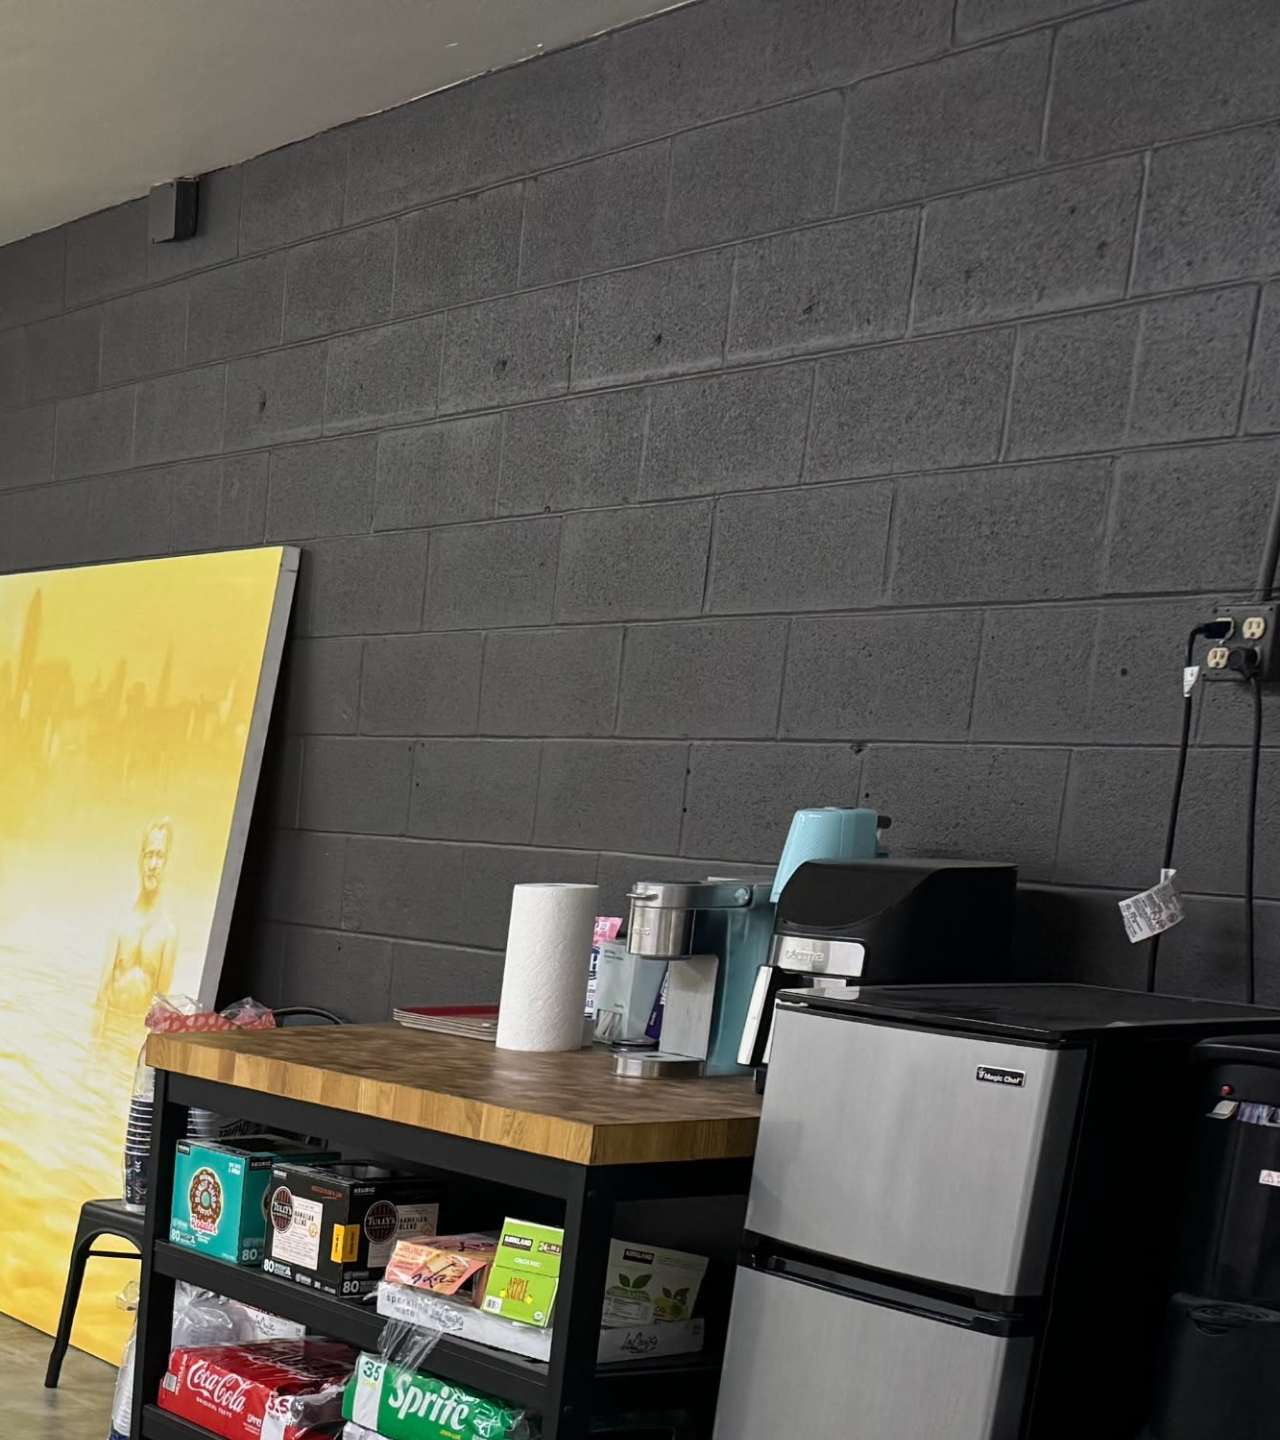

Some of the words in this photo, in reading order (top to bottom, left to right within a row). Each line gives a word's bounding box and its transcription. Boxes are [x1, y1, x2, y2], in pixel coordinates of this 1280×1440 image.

[241, 1248, 258, 1261] 80
[263, 1258, 274, 1272] 80
[342, 1280, 360, 1293] 80
[362, 1360, 382, 1382] 35
[388, 1373, 470, 1432] Sprite
